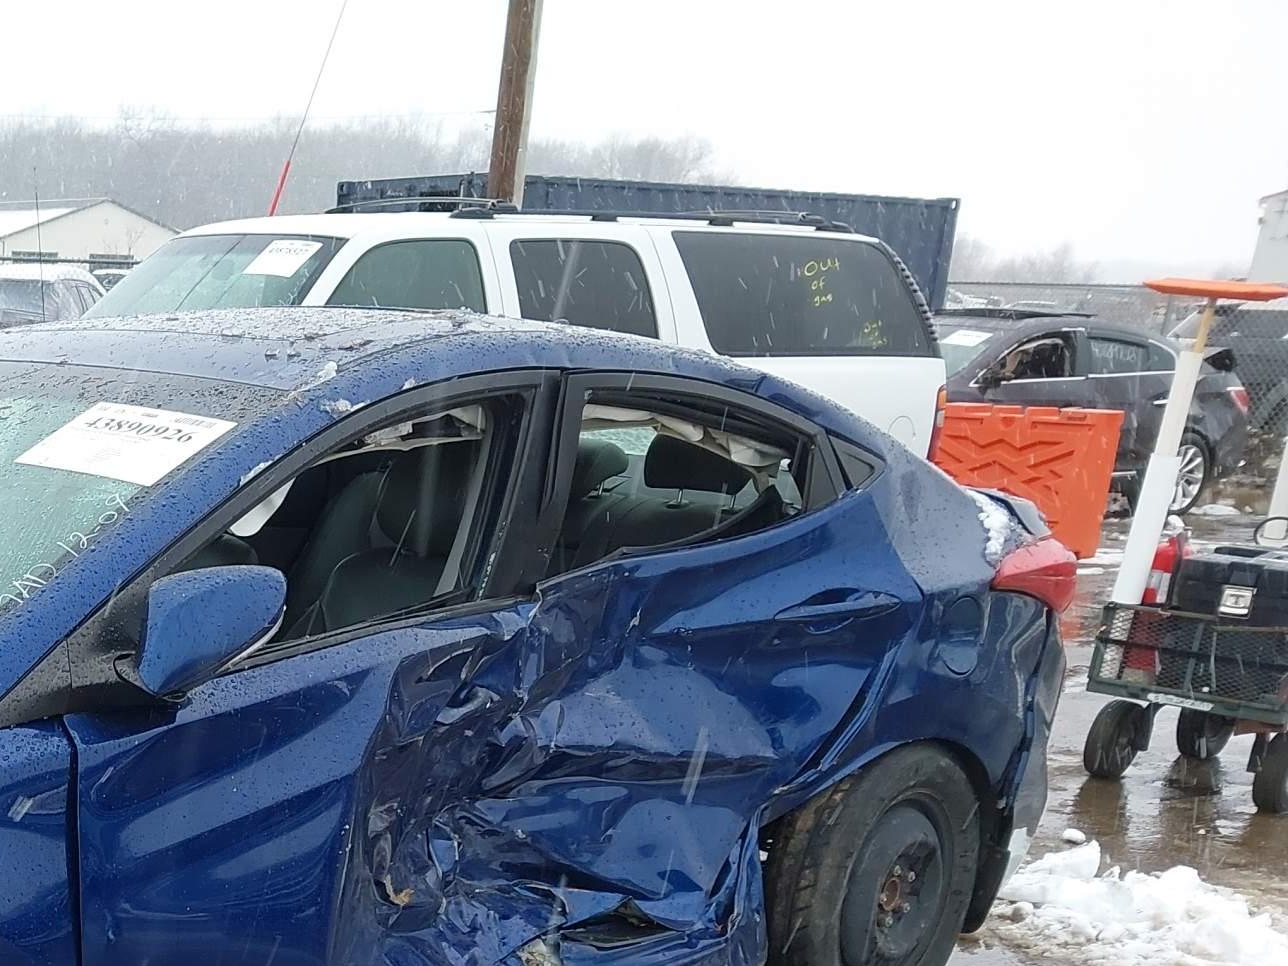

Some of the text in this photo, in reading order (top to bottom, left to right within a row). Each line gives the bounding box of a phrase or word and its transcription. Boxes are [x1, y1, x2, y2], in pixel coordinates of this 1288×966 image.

[811, 276, 825, 290] of
[813, 293, 833, 307] gas
[84, 416, 196, 444] 43890926
[56, 493, 131, 558] 12-09
